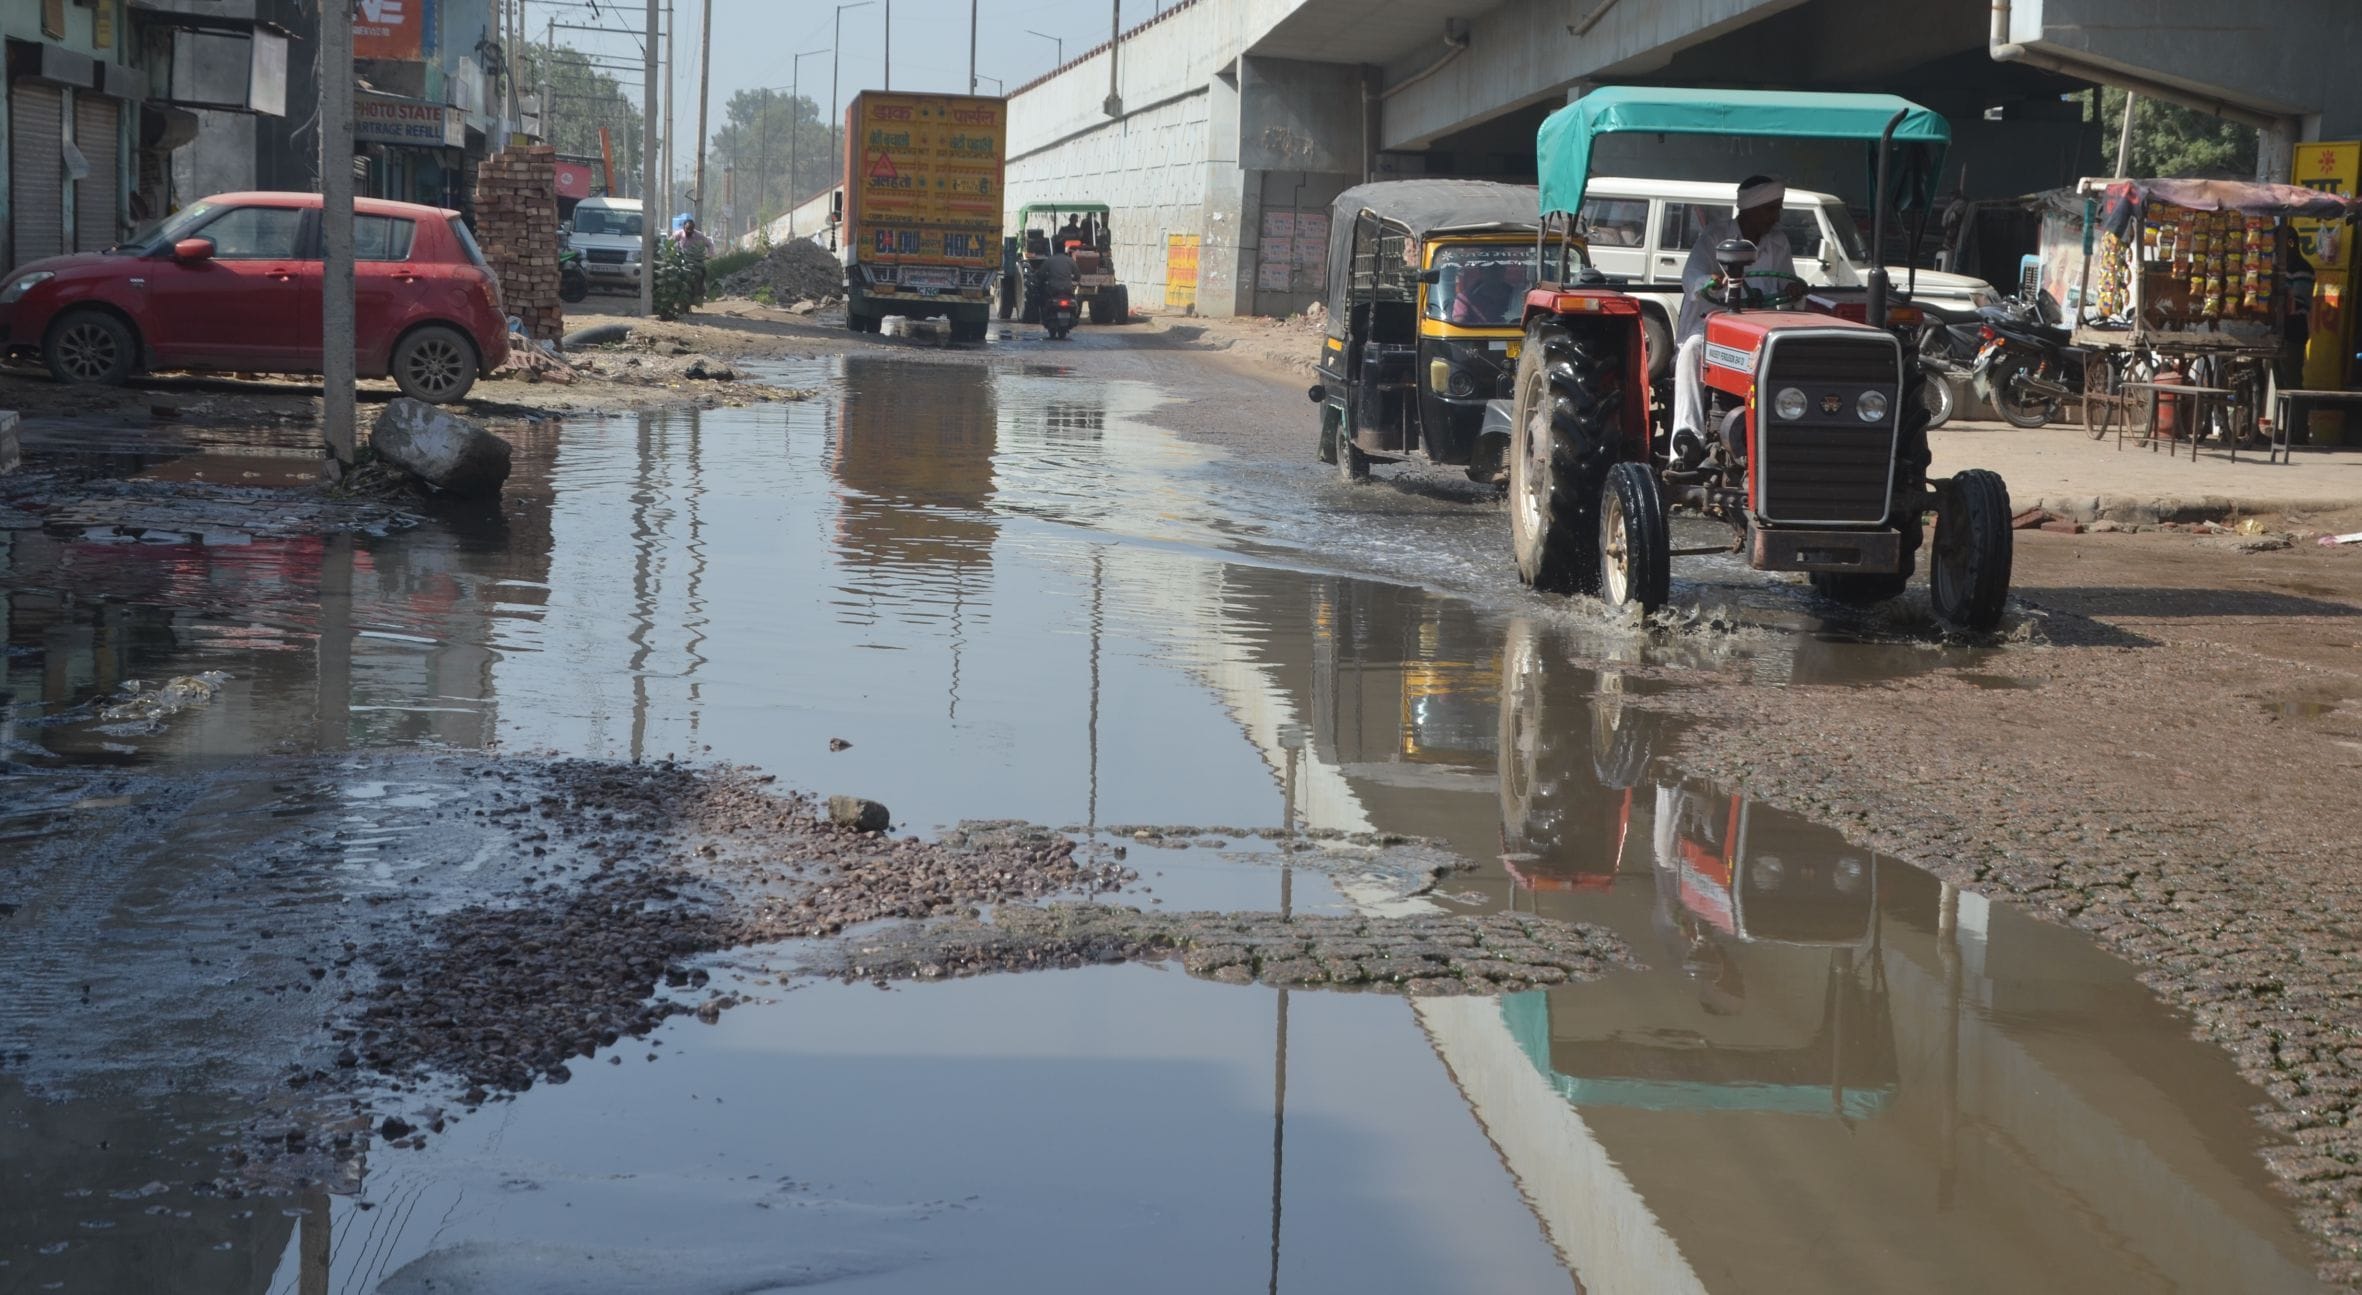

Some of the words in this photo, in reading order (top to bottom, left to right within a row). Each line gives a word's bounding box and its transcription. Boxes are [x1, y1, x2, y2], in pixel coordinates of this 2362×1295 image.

[354, 101, 396, 118] PHOTO
[398, 105, 441, 121] STATE
[354, 120, 402, 136] ARTRAGE
[405, 124, 441, 138] REFILL
[880, 268, 890, 281] J
[966, 272, 976, 285] K
